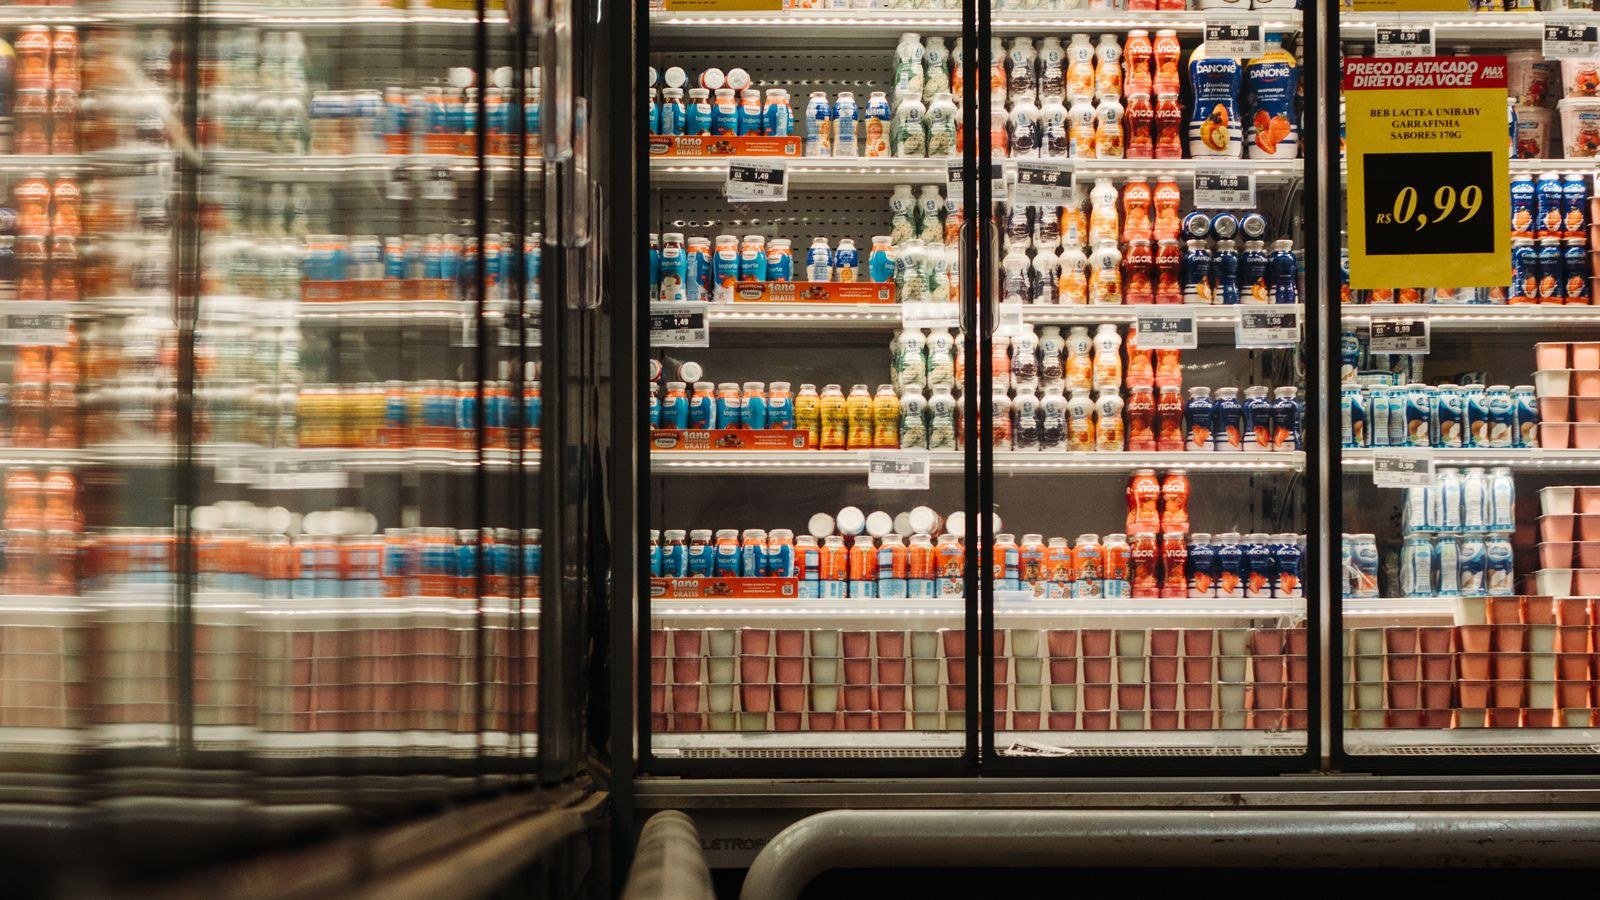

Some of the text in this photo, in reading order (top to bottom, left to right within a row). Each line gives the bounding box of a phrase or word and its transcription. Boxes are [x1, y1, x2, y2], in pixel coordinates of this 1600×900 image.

[1230, 29, 1249, 38] 10,59
[1400, 32, 1416, 42] 0,99
[1346, 61, 1504, 79] PREÇO DE ATACADO MAX
[1353, 71, 1473, 88] DIRETO PRA VOCÊ
[1370, 107, 1482, 118] BEB LACTEA UNIBABY
[1391, 120, 1460, 128] GARRAFINHA
[1390, 130, 1462, 140] SABORES 170G
[754, 172, 769, 180] 1,49
[1220, 179, 1238, 187] 10,59
[1393, 185, 1483, 231] 0,99
[1126, 255, 1152, 264] VIGOR
[674, 318, 689, 327] 1,49
[1161, 321, 1178, 331] 2,14
[1394, 325, 1411, 334] 0,99
